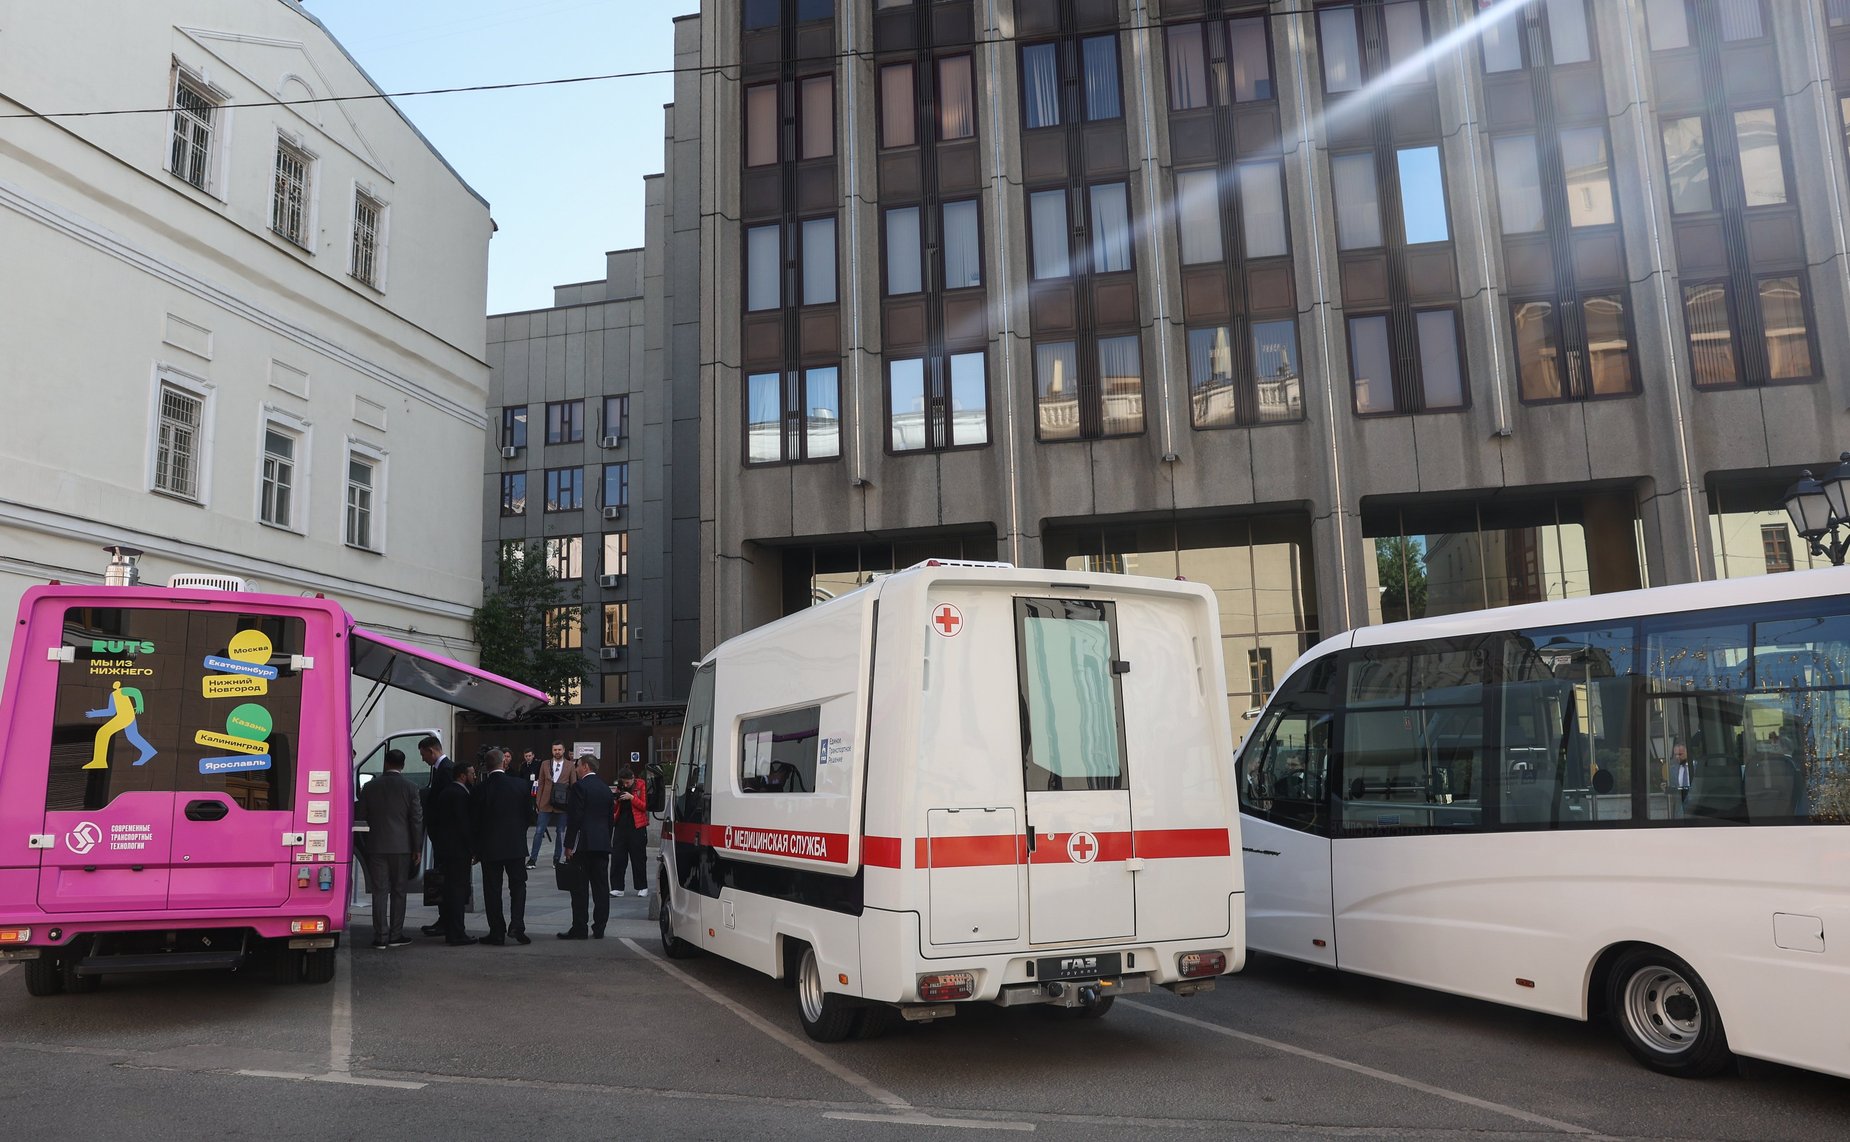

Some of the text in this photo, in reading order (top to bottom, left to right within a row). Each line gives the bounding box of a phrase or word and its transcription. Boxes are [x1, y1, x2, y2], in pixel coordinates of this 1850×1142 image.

[92, 640, 155, 654] RUTS
[233, 645, 269, 654] Москва
[91, 659, 133, 668] МЫ ИЗ
[208, 659, 275, 676] Екатеринбург
[90, 668, 153, 676] НИЖНЕГО
[209, 678, 253, 686] Нижний
[231, 716, 267, 732] Казань
[200, 734, 264, 752] Калининград
[205, 760, 266, 770] Ярославль
[111, 824, 151, 832] СОВРЕМЕННЫЕ
[110, 833, 153, 841] ТРАНСПОРТНЫЕ
[109, 842, 145, 850] ТЕХНОЛОГИИ
[733, 829, 827, 857] МЕДИЦИНСКАЯ СЛУЖБА
[1061, 957, 1097, 970] ГАЗ
